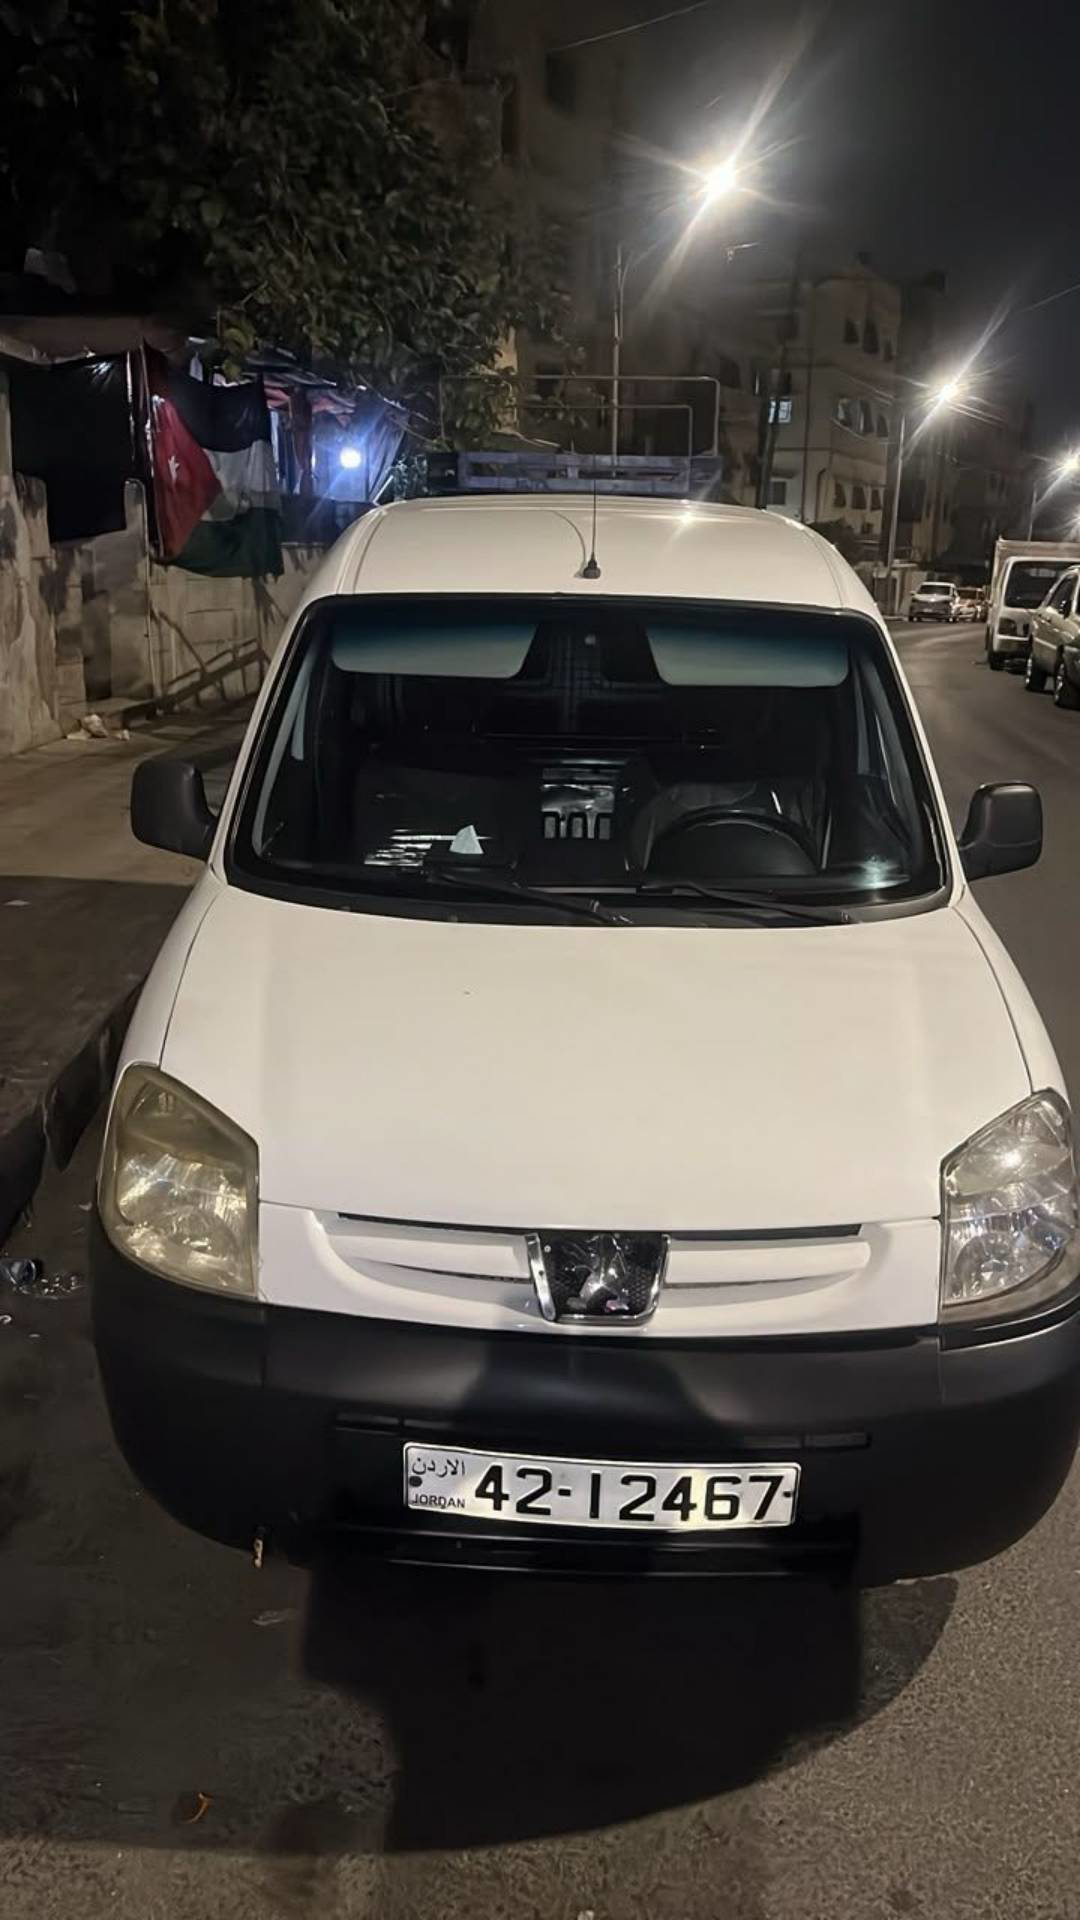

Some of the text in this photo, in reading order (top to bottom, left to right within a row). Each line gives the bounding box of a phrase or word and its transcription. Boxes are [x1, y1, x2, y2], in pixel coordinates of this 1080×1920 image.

[412, 1457, 466, 1478] الاردن
[412, 1494, 466, 1509] JORDAN
[475, 1464, 785, 1522] 42-12467
